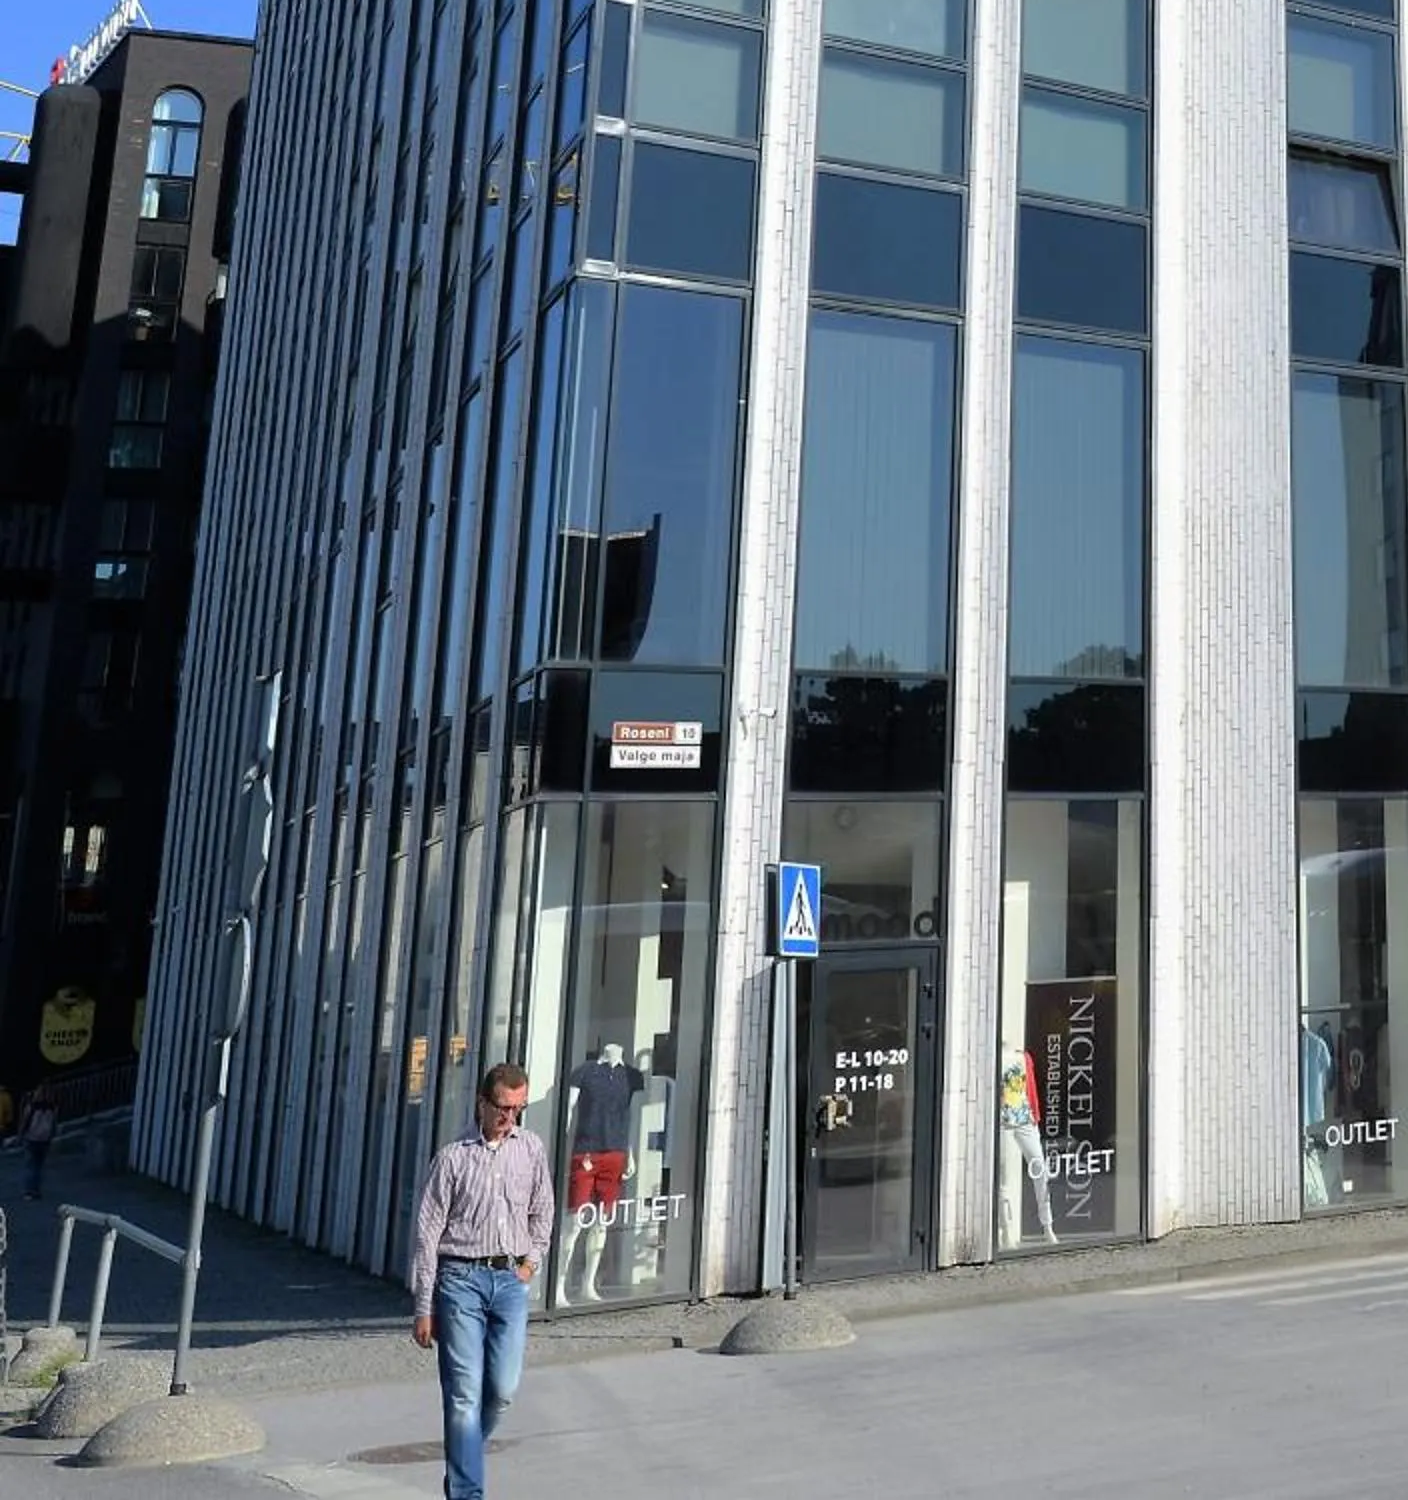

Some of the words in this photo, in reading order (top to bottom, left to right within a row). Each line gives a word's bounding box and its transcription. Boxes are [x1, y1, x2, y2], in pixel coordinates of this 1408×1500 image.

[620, 726, 670, 739] Roseni
[618, 749, 657, 764] Valge
[661, 749, 695, 764] maja
[835, 1051, 861, 1069] E-L
[864, 1047, 909, 1067] 10-20
[835, 1077, 847, 1093] P
[849, 1073, 894, 1093] 11-18
[1046, 1033, 1061, 1137] ESTABLISHED
[1065, 993, 1096, 1218] NICKELSON
[1325, 1118, 1399, 1147] OUTLET
[1028, 1149, 1115, 1179] OUTLET
[577, 1193, 687, 1228] OUTLET
